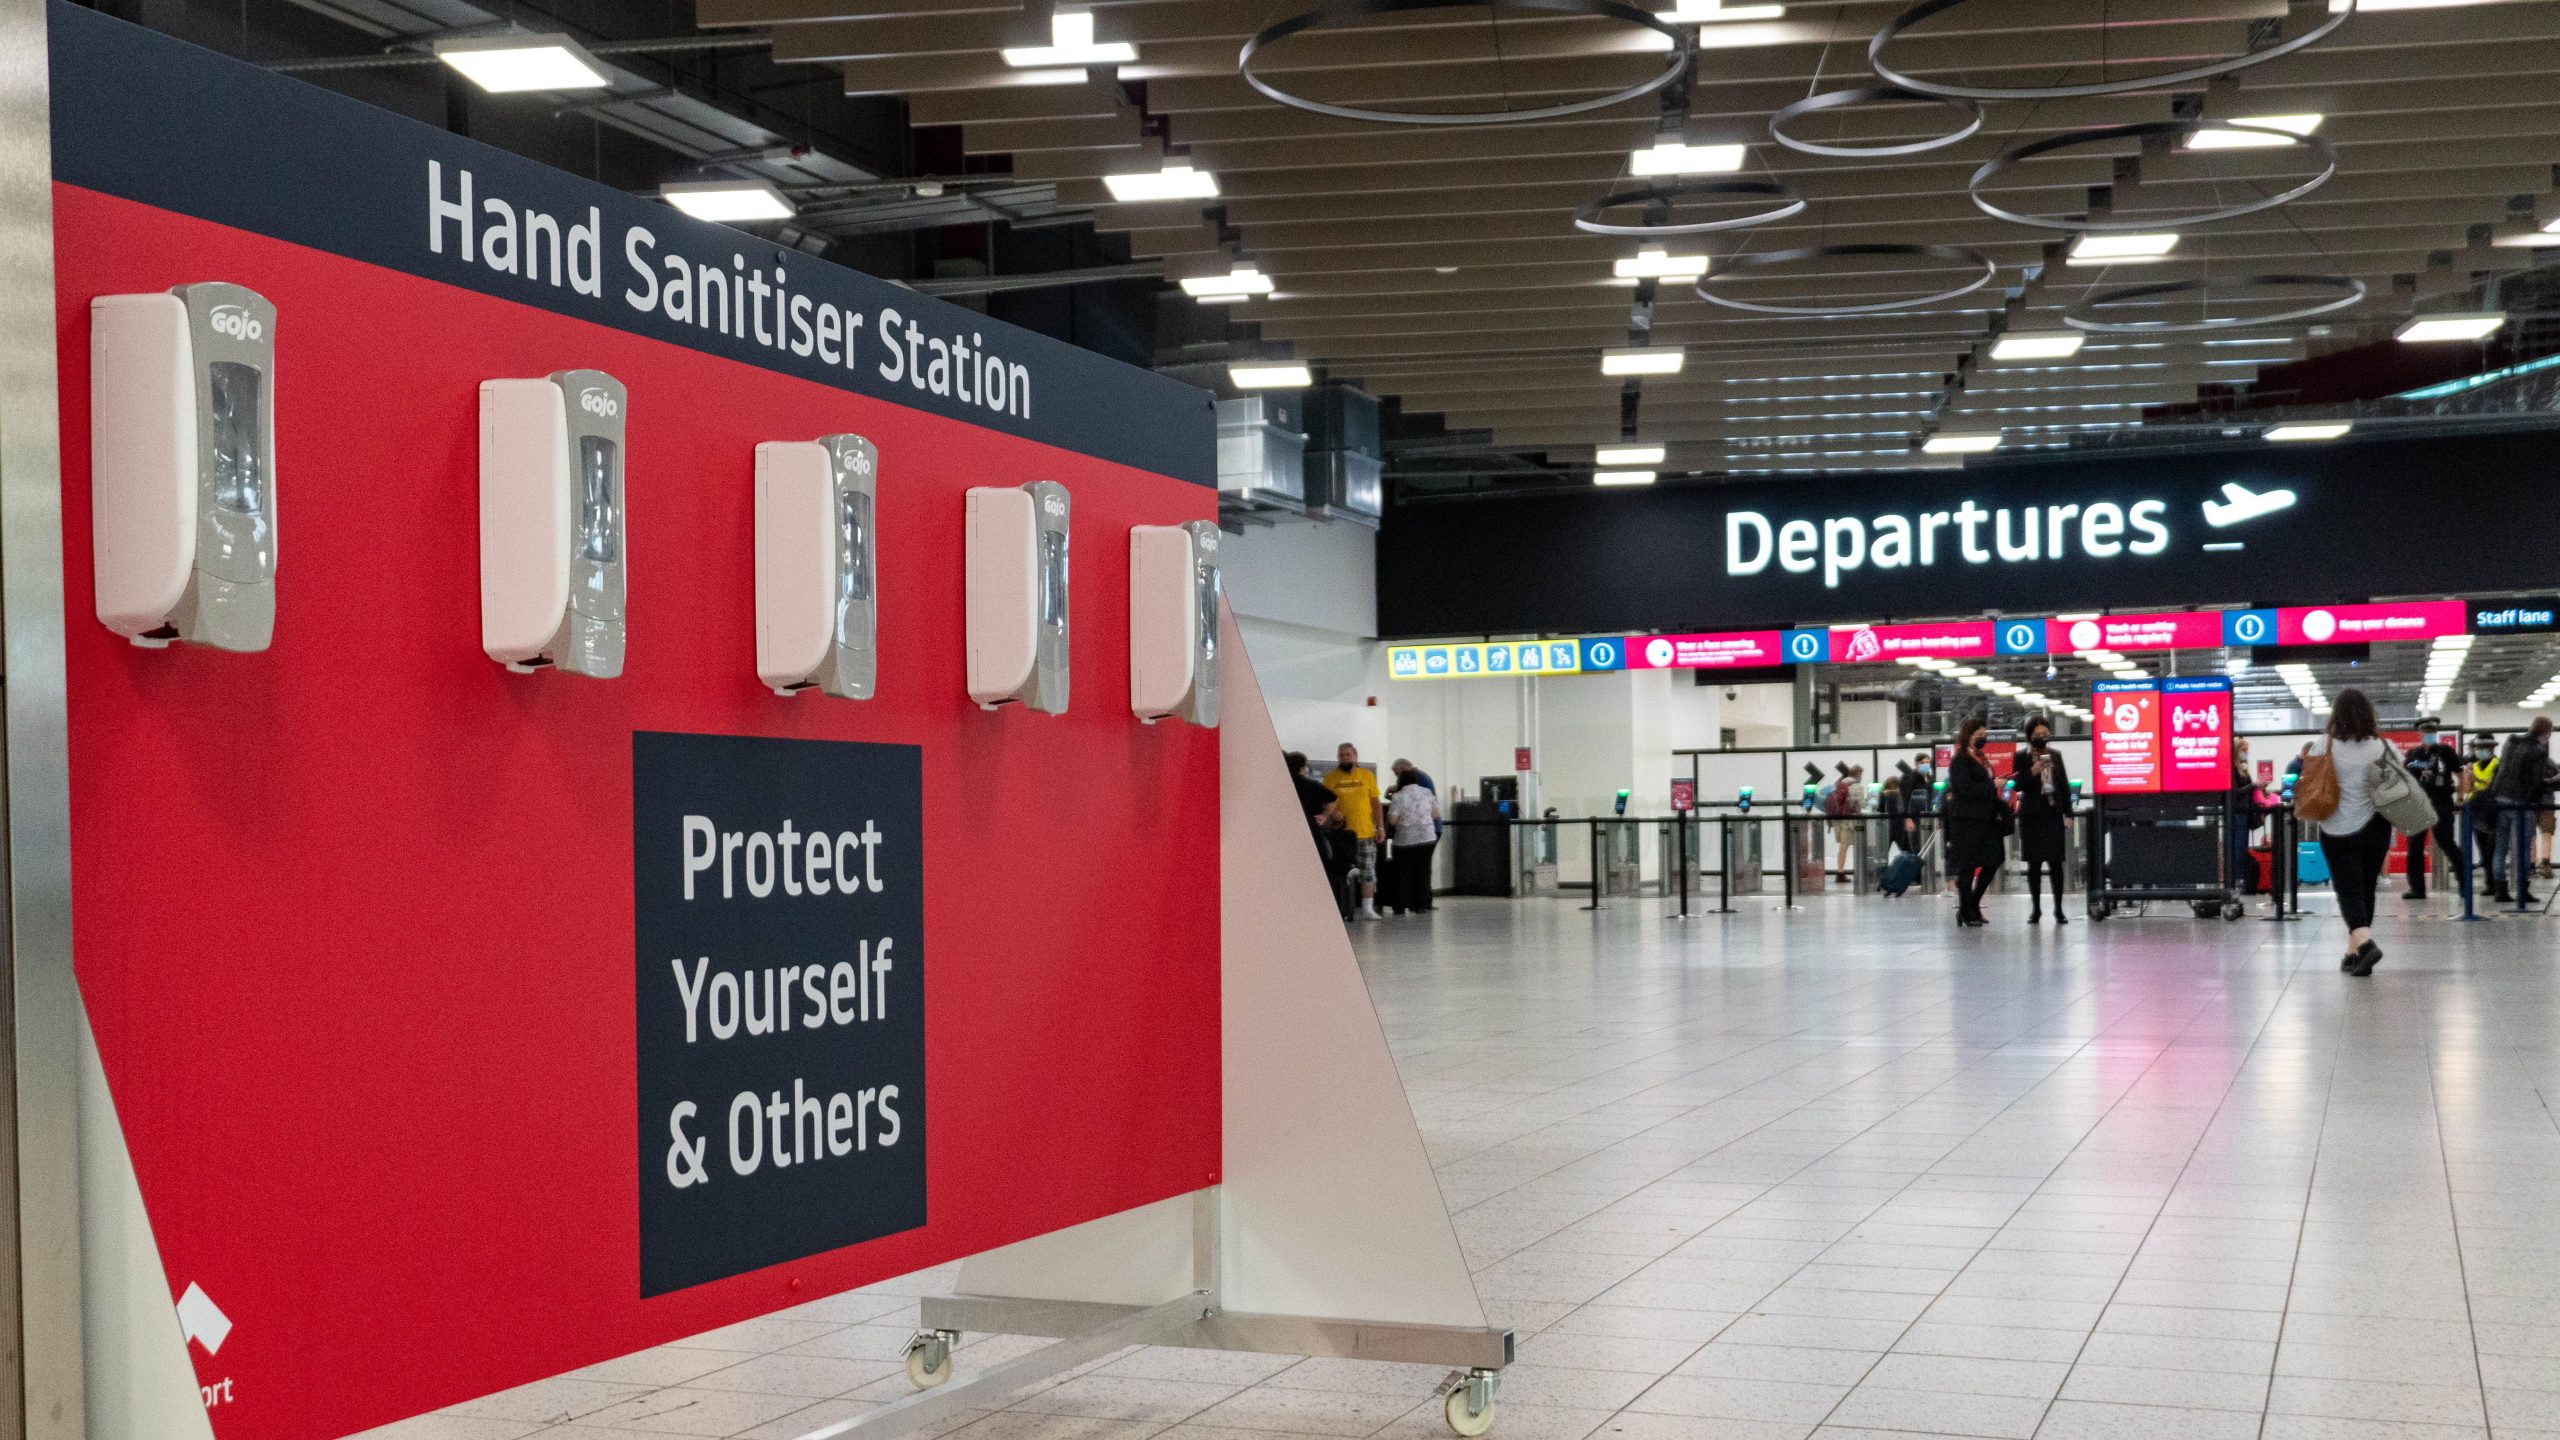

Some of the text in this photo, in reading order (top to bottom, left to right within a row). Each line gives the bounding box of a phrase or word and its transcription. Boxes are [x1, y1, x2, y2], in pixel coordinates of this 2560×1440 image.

[428, 159, 1032, 421] Hand Sanitiser Station
[1725, 498, 2171, 589] Departures
[2339, 617, 2426, 631] Keep your distance
[2477, 609, 2553, 626] Staff lane
[2172, 736, 2220, 748] Keep your
[2175, 747, 2218, 759] distance
[683, 815, 885, 901] Protect
[670, 936, 895, 1044] Yourself
[666, 1078, 902, 1188] & Others
